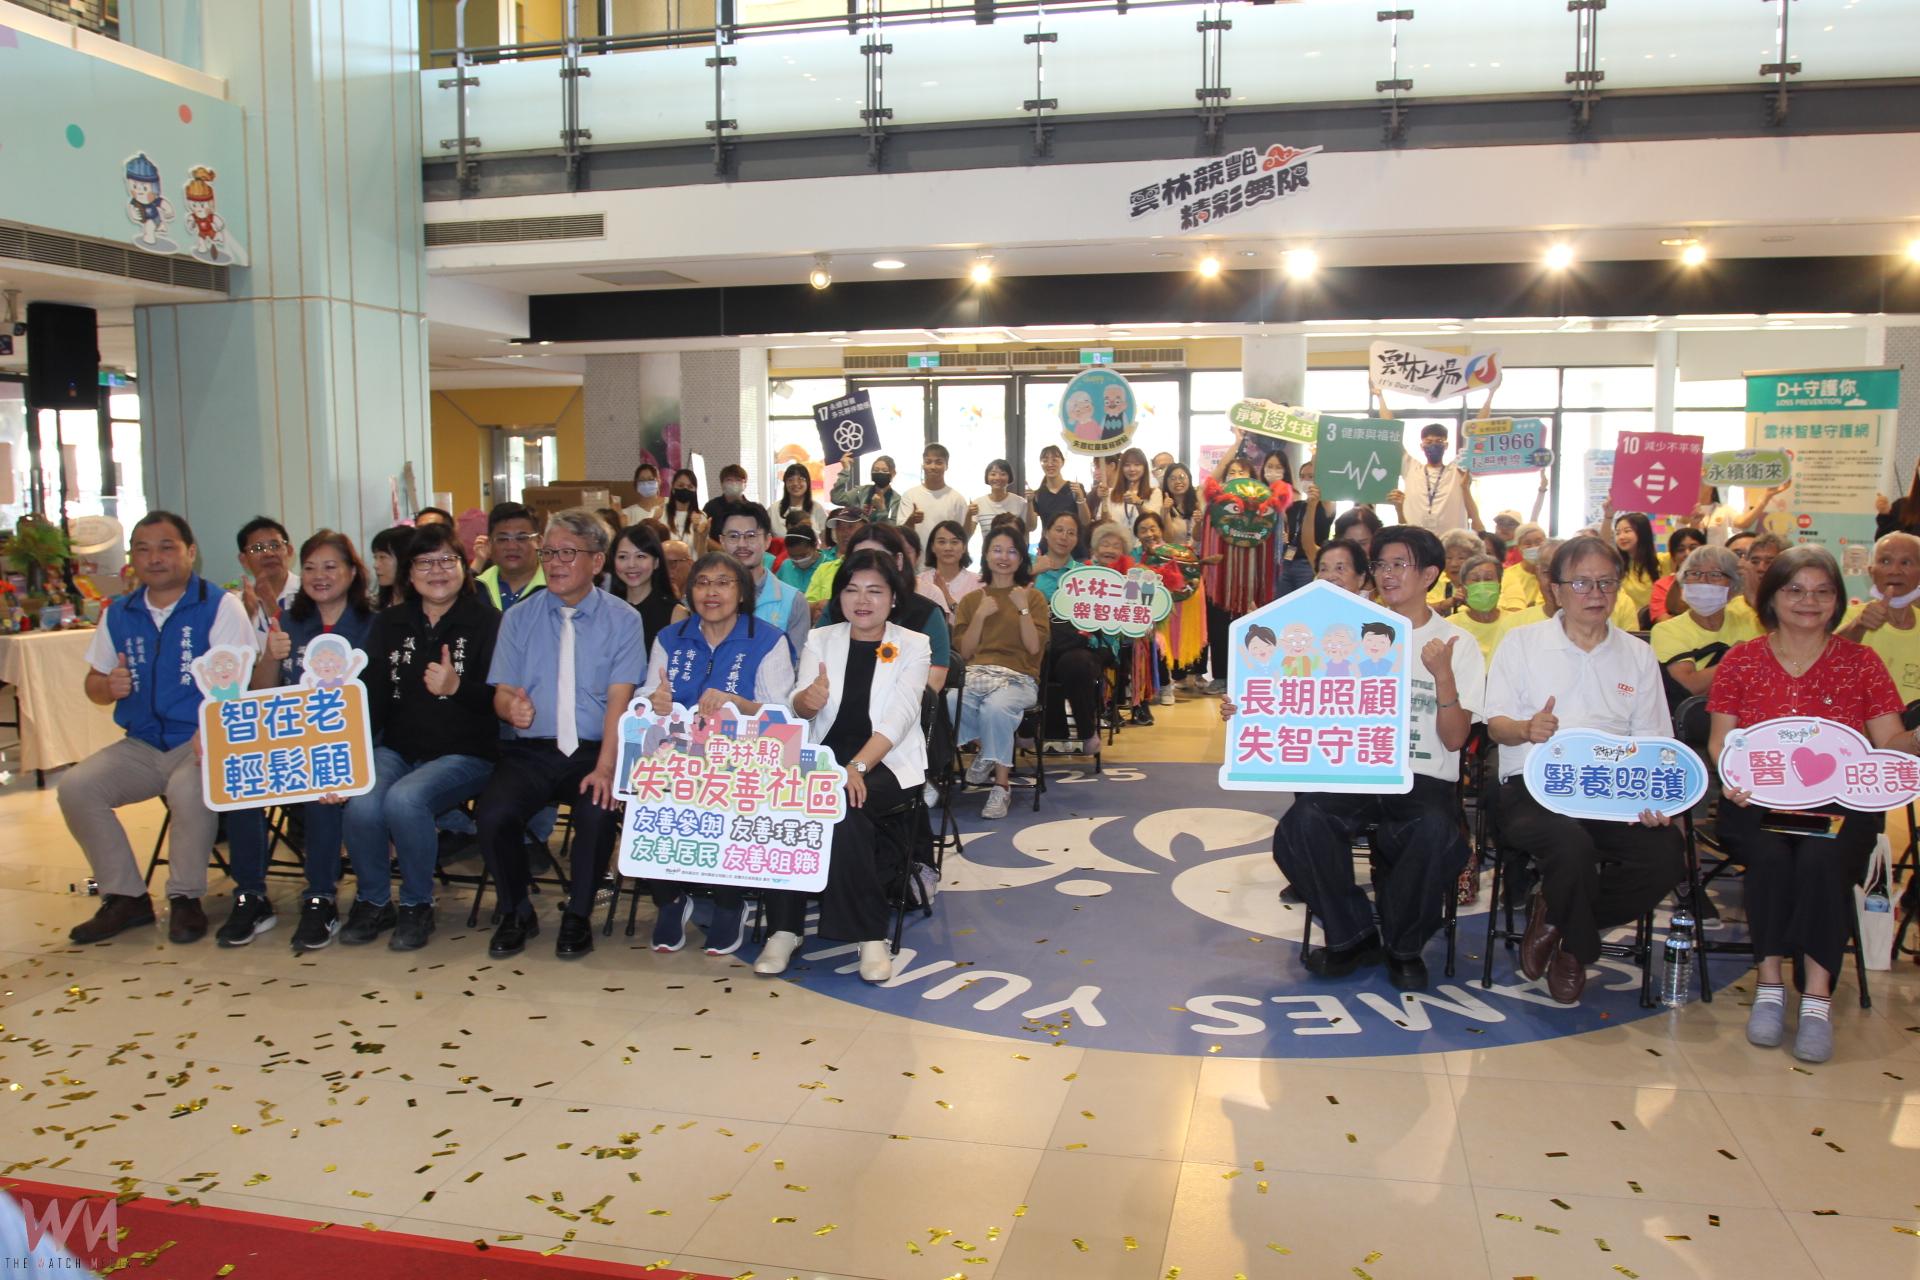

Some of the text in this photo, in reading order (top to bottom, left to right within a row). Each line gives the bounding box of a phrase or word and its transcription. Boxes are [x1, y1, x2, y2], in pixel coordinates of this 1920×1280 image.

[1181, 161, 1309, 230] 精彩無限
[1776, 379, 1857, 398] D+守護你
[818, 405, 829, 421] 17
[1326, 423, 1337, 442] 3
[1490, 432, 1534, 452] 1966
[1622, 436, 1640, 454] 10
[222, 689, 345, 744] 智在老
[1241, 678, 1398, 716] 長期照顧
[707, 737, 781, 766] 雲林縣
[1238, 725, 1395, 765] 失智守護
[224, 743, 353, 799] 輕鬆顧
[632, 754, 839, 815] 失智友善社區
[1544, 763, 1687, 801] 醫養照護
[1749, 750, 1920, 795] 醫 照護
[633, 806, 824, 849] 友善參與 友善環境
[631, 835, 821, 875] 友善居民 友善組織
